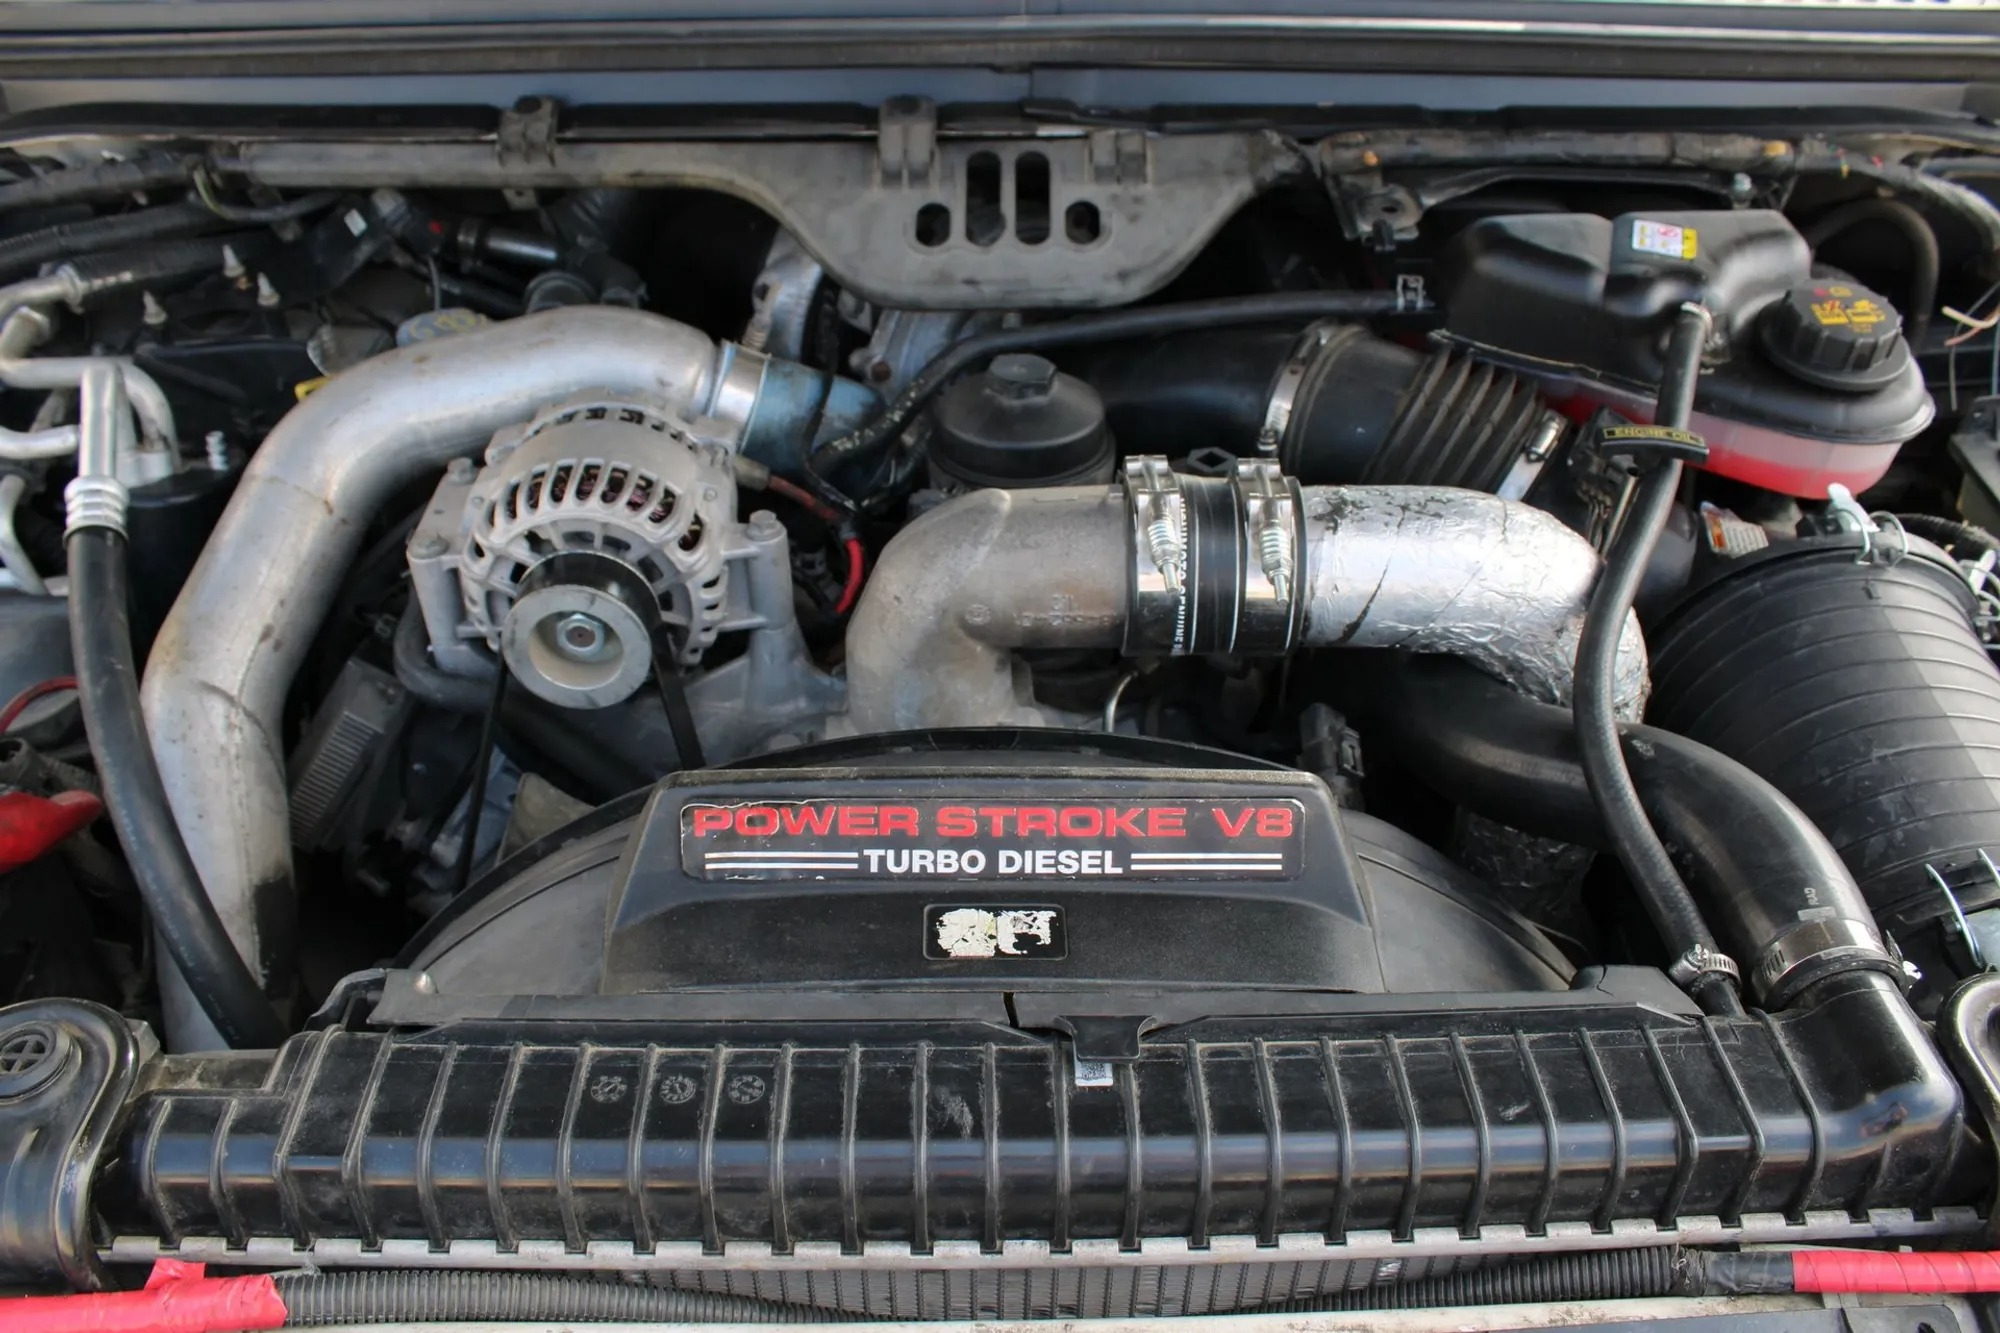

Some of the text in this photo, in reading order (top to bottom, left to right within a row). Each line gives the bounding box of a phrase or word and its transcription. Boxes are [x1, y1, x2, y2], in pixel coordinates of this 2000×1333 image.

[693, 806, 1293, 837] POWER STROKE V8
[863, 849, 1123, 874] TURBO DIESEL
